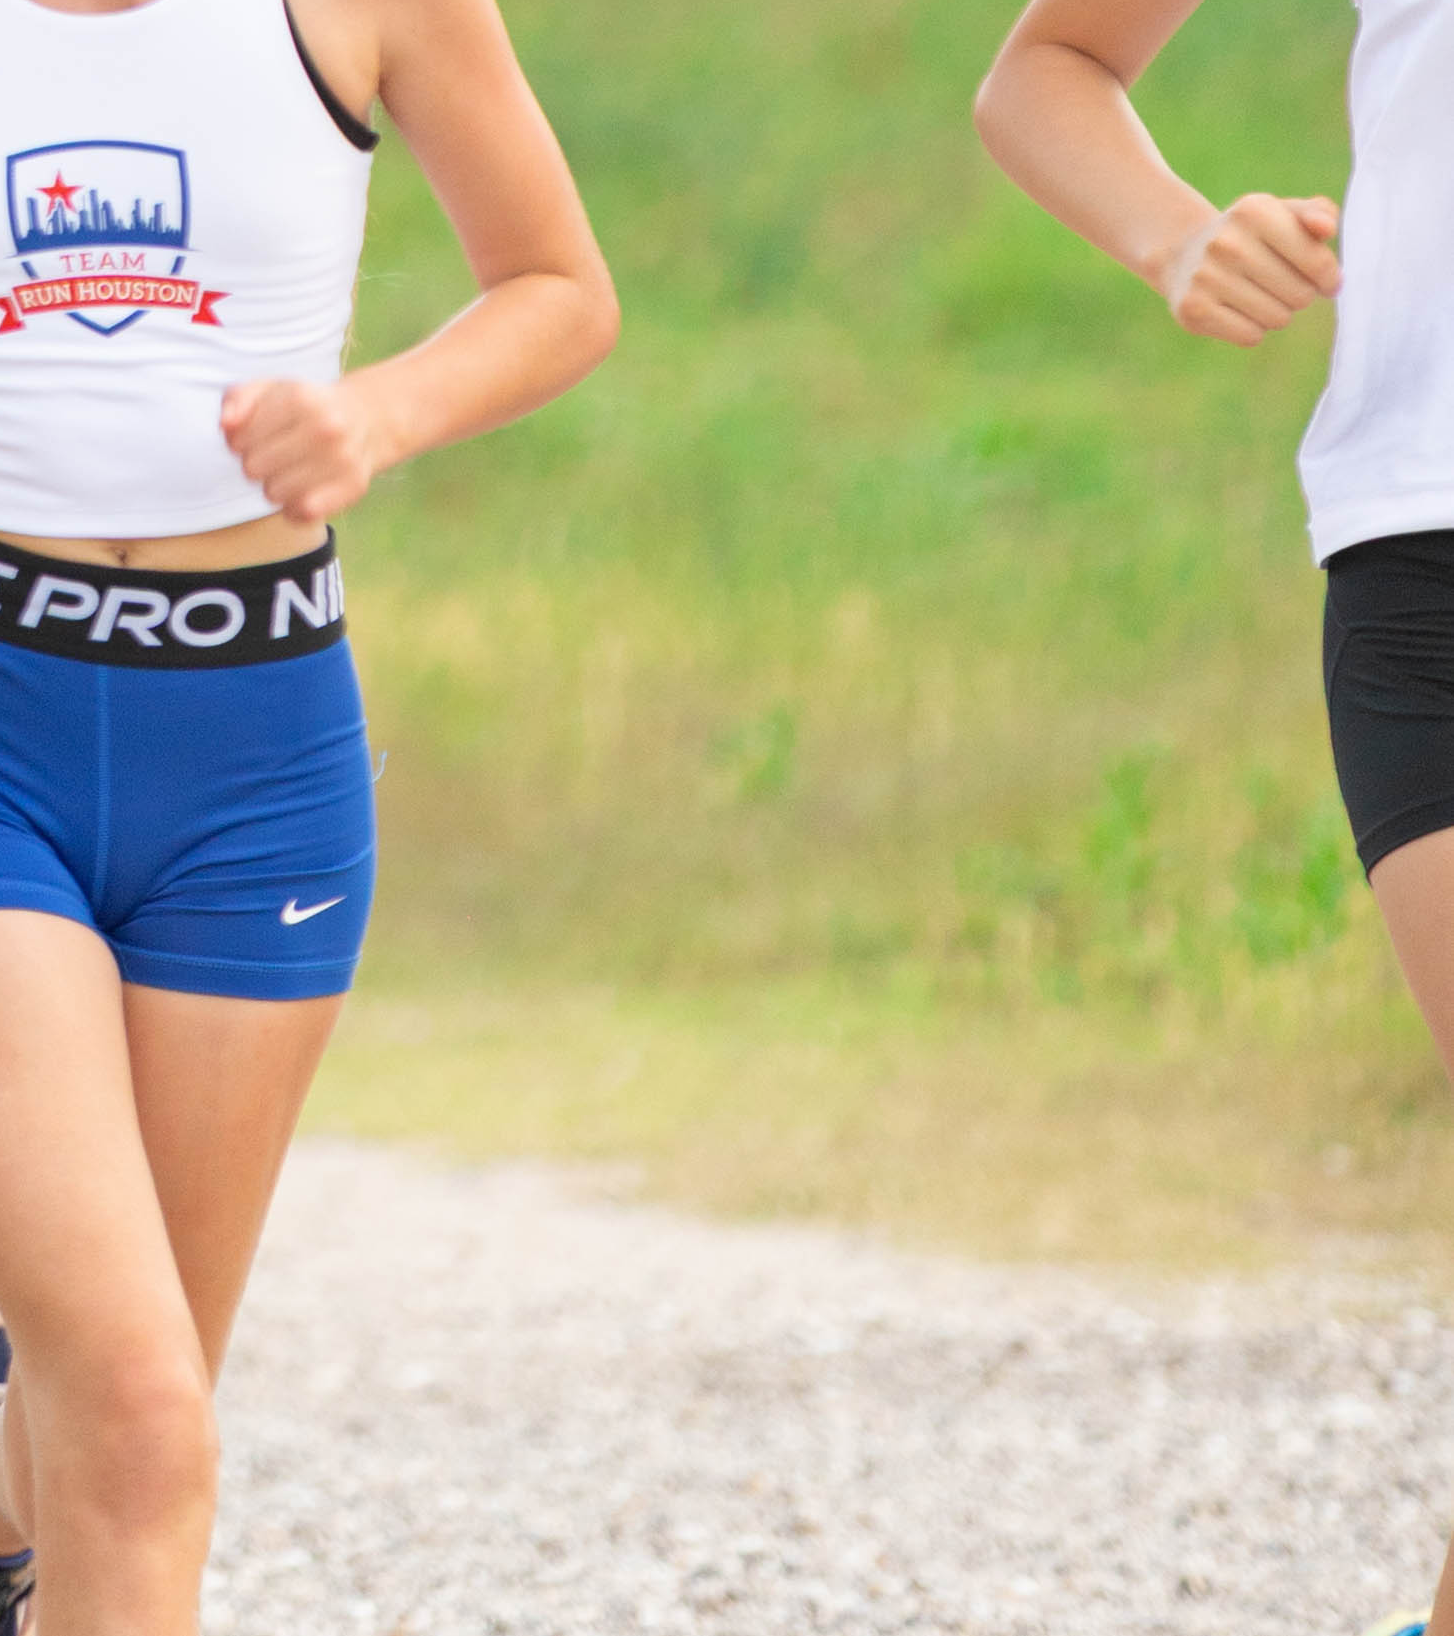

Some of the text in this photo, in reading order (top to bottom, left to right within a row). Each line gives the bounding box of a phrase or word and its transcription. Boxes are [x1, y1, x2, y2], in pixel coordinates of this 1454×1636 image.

[59, 251, 147, 273] TEAM
[18, 280, 195, 309] RUN HOUSTON
[17, 574, 246, 648] PRO
[270, 556, 345, 639] NI
